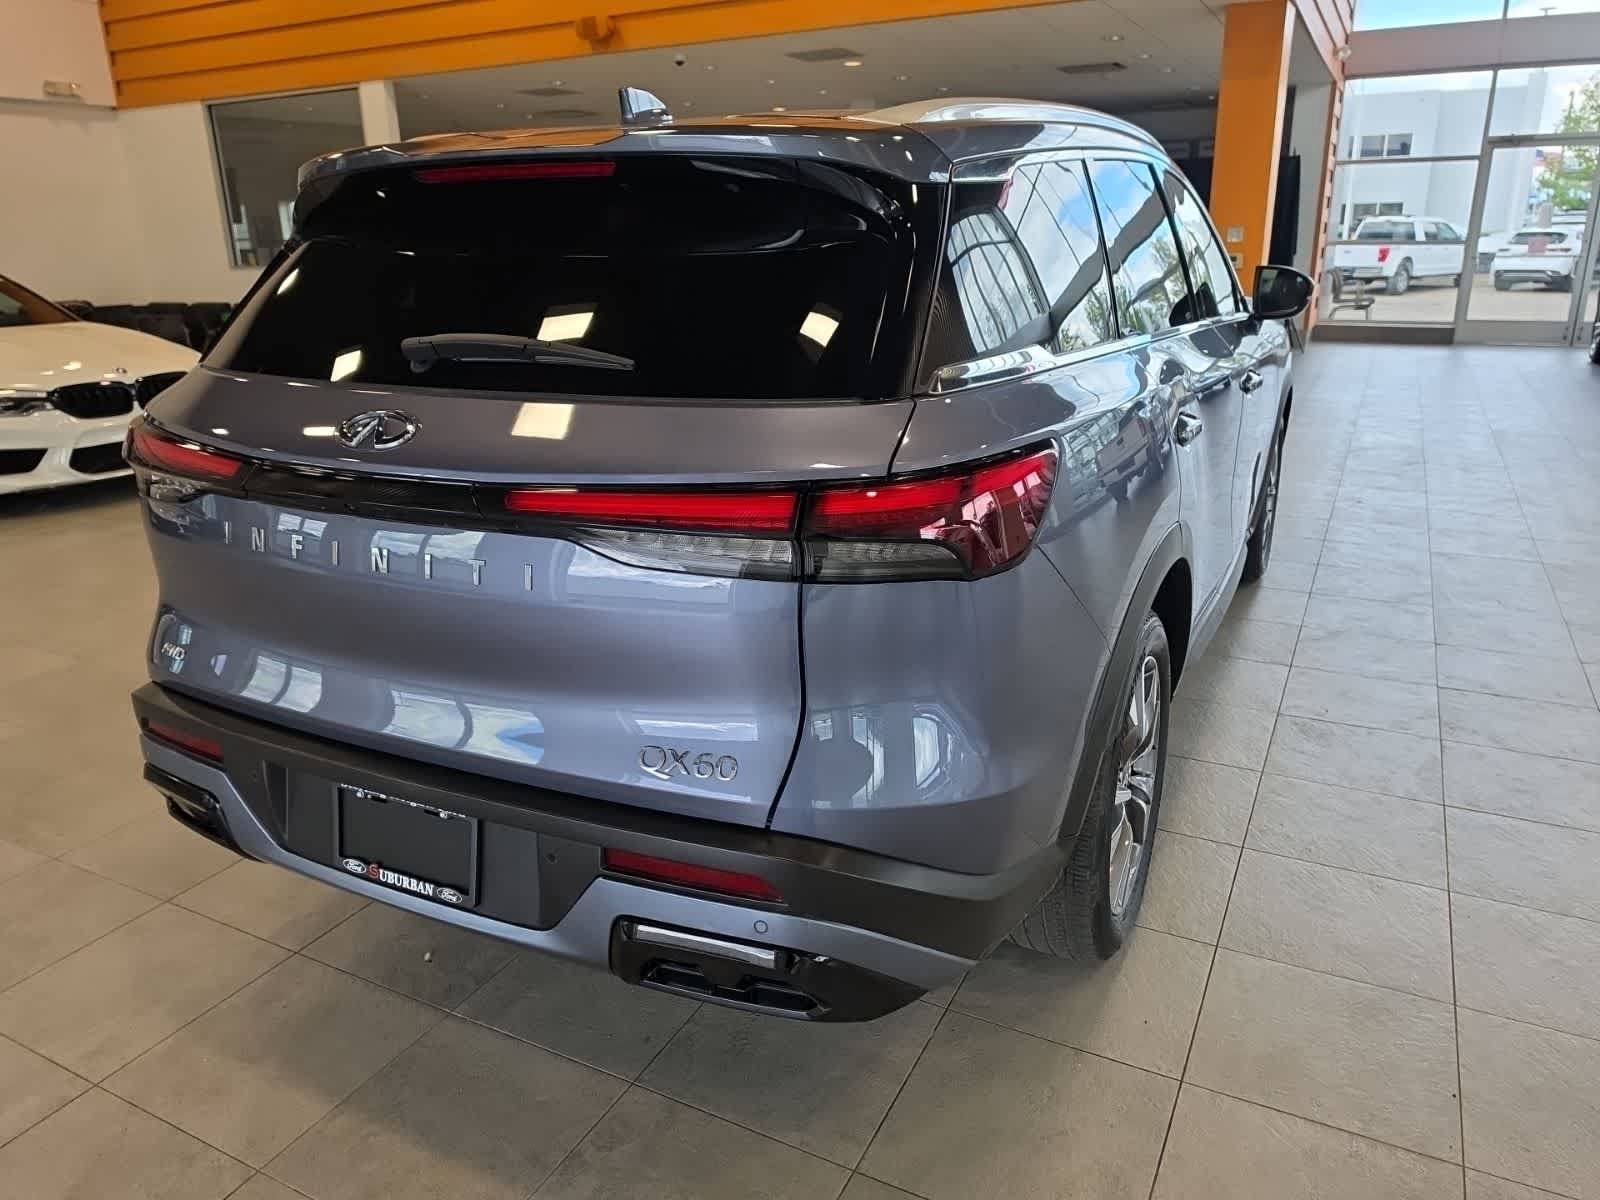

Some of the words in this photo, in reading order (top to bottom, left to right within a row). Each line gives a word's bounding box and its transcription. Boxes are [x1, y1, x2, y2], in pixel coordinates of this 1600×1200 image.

[223, 521, 534, 591] INFINITI
[639, 745, 739, 781] QX60
[344, 859, 366, 873] Ford
[368, 864, 434, 896] SUBURBAN
[438, 888, 461, 903] Ford
